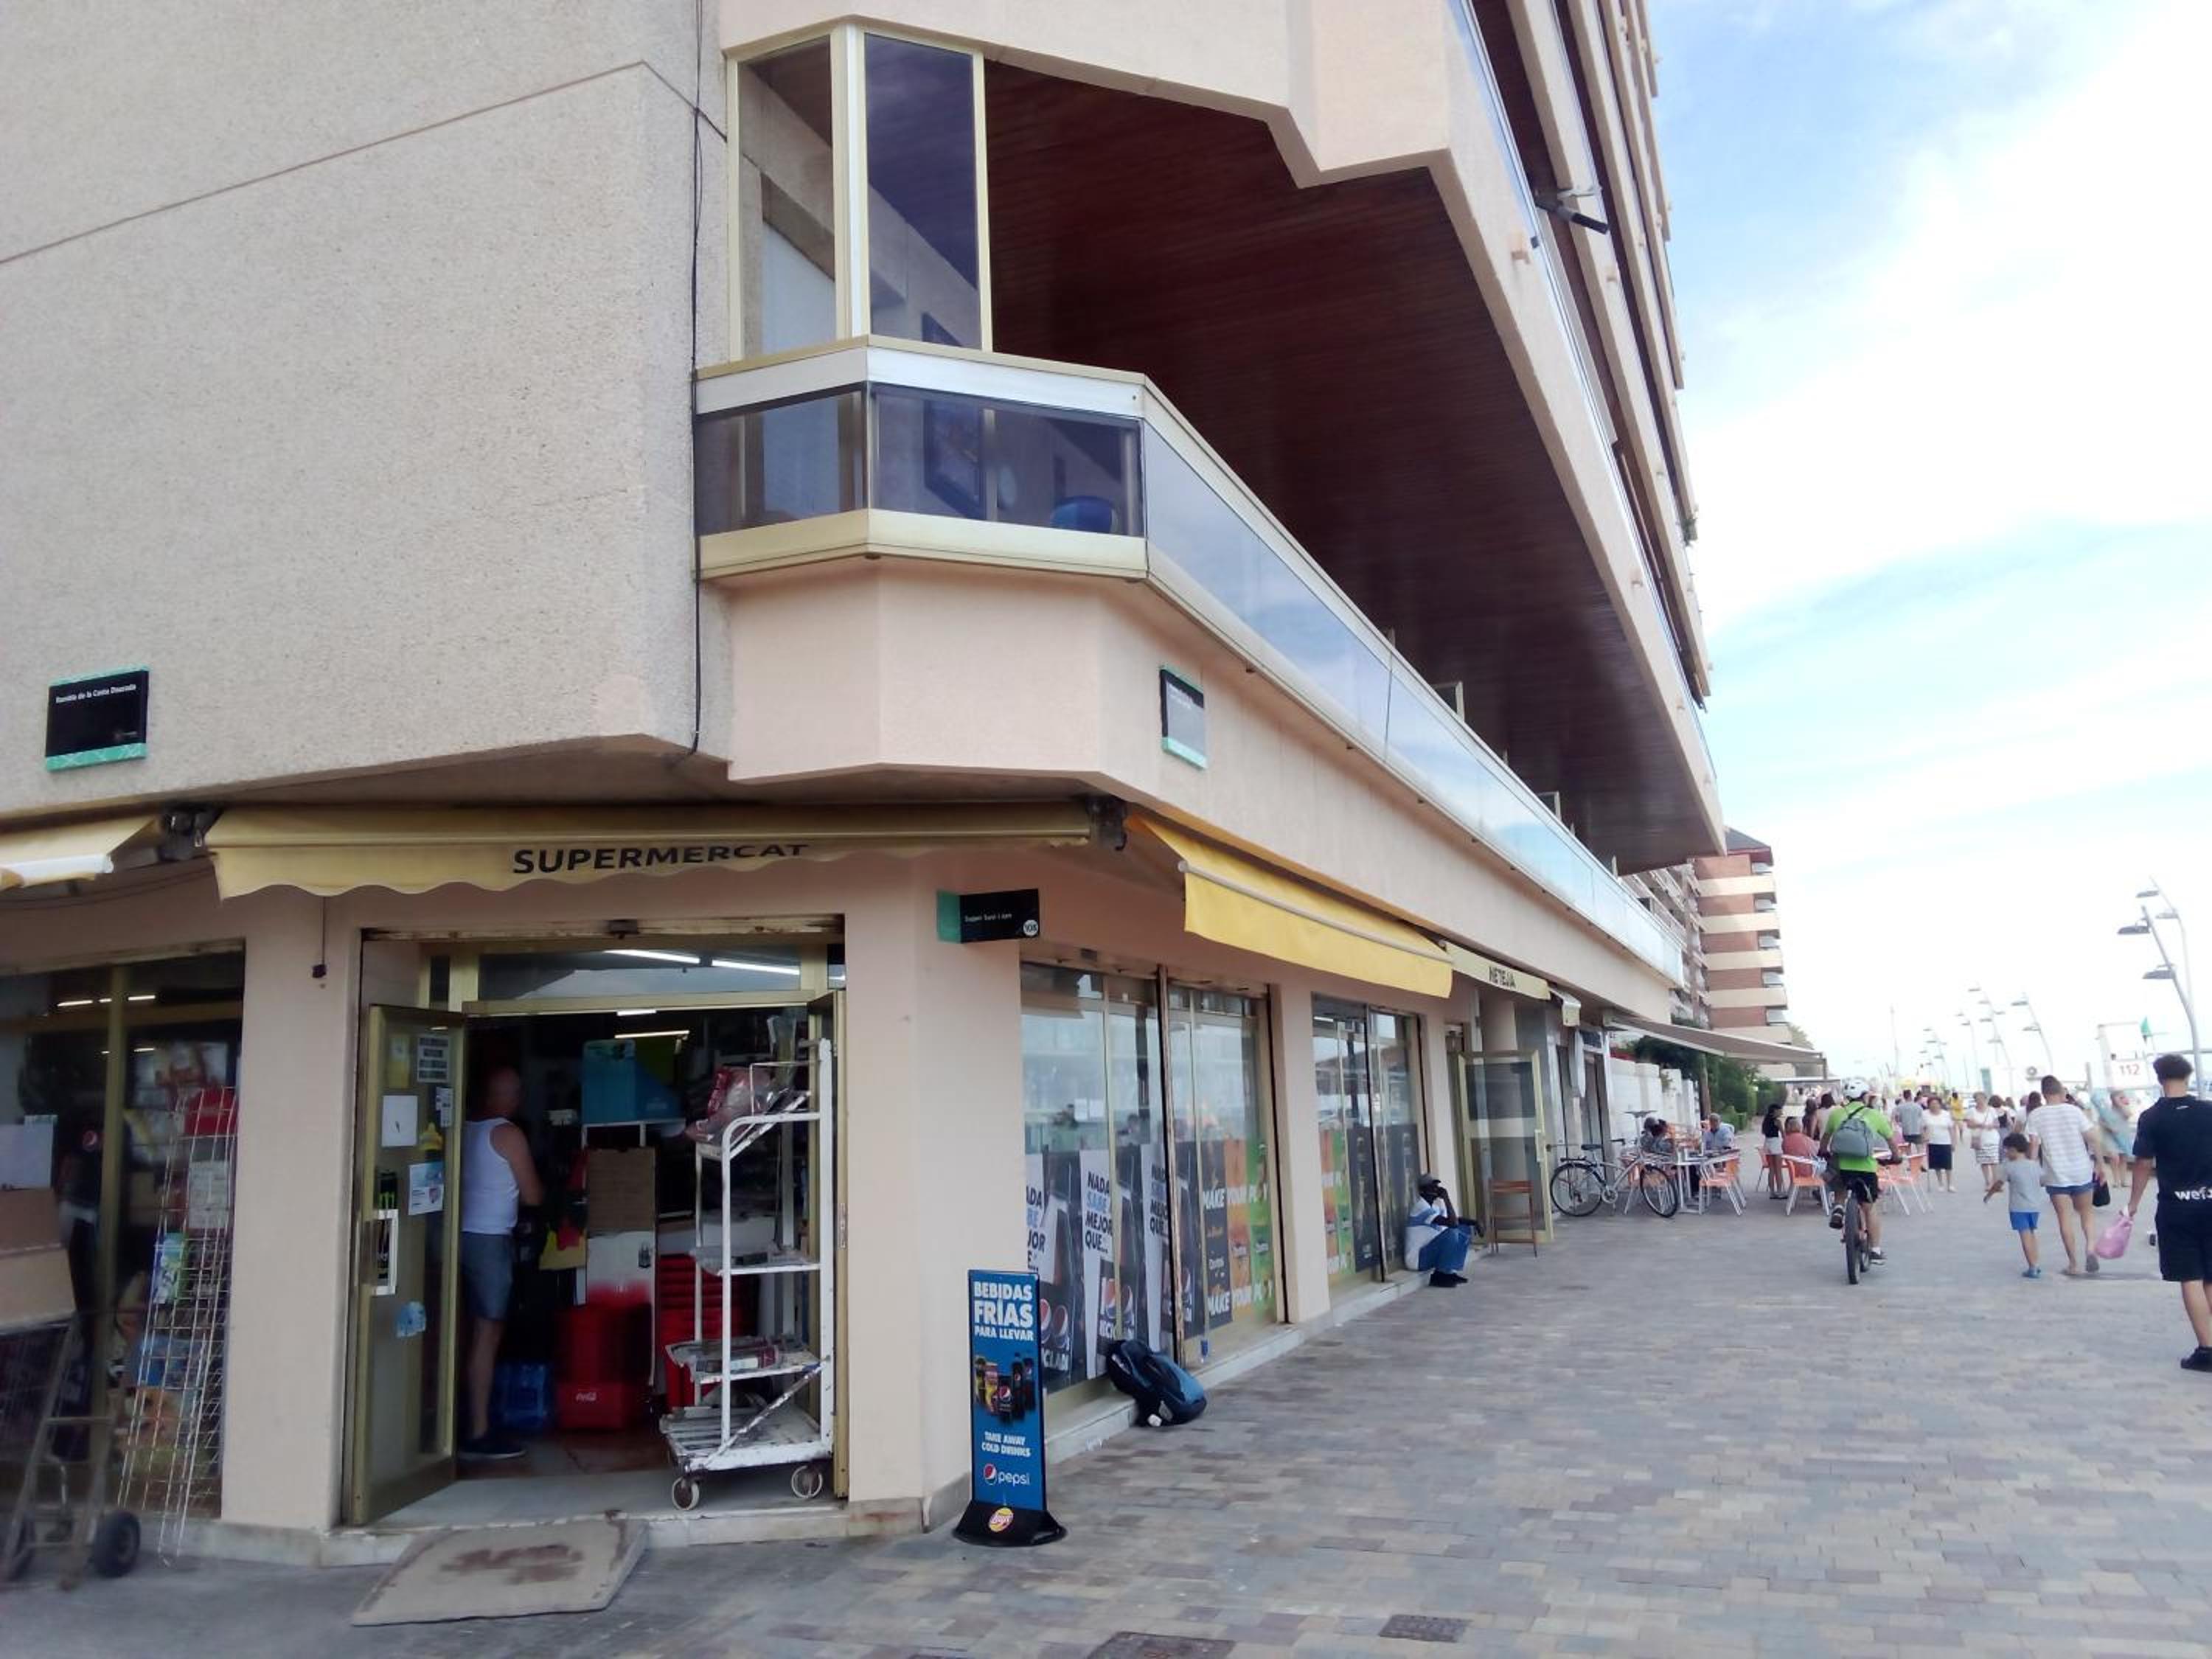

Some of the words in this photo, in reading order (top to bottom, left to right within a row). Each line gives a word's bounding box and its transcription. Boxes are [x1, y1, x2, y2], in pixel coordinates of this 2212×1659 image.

[513, 844, 810, 874] SUPERMERCAT
[2120, 1064, 2140, 1076] 112
[1203, 1188, 1225, 1210] MAKE
[974, 1281, 1033, 1301] BEBIDAS
[974, 1325, 998, 1338] PARA
[998, 1327, 1034, 1341] LLEVAR
[984, 1430, 1002, 1442] TAKE
[1002, 1433, 1026, 1446] AWAY
[981, 1441, 1001, 1453] COLD
[1001, 1444, 1032, 1458] DRINKS
[998, 1471, 1030, 1486] pepsi
